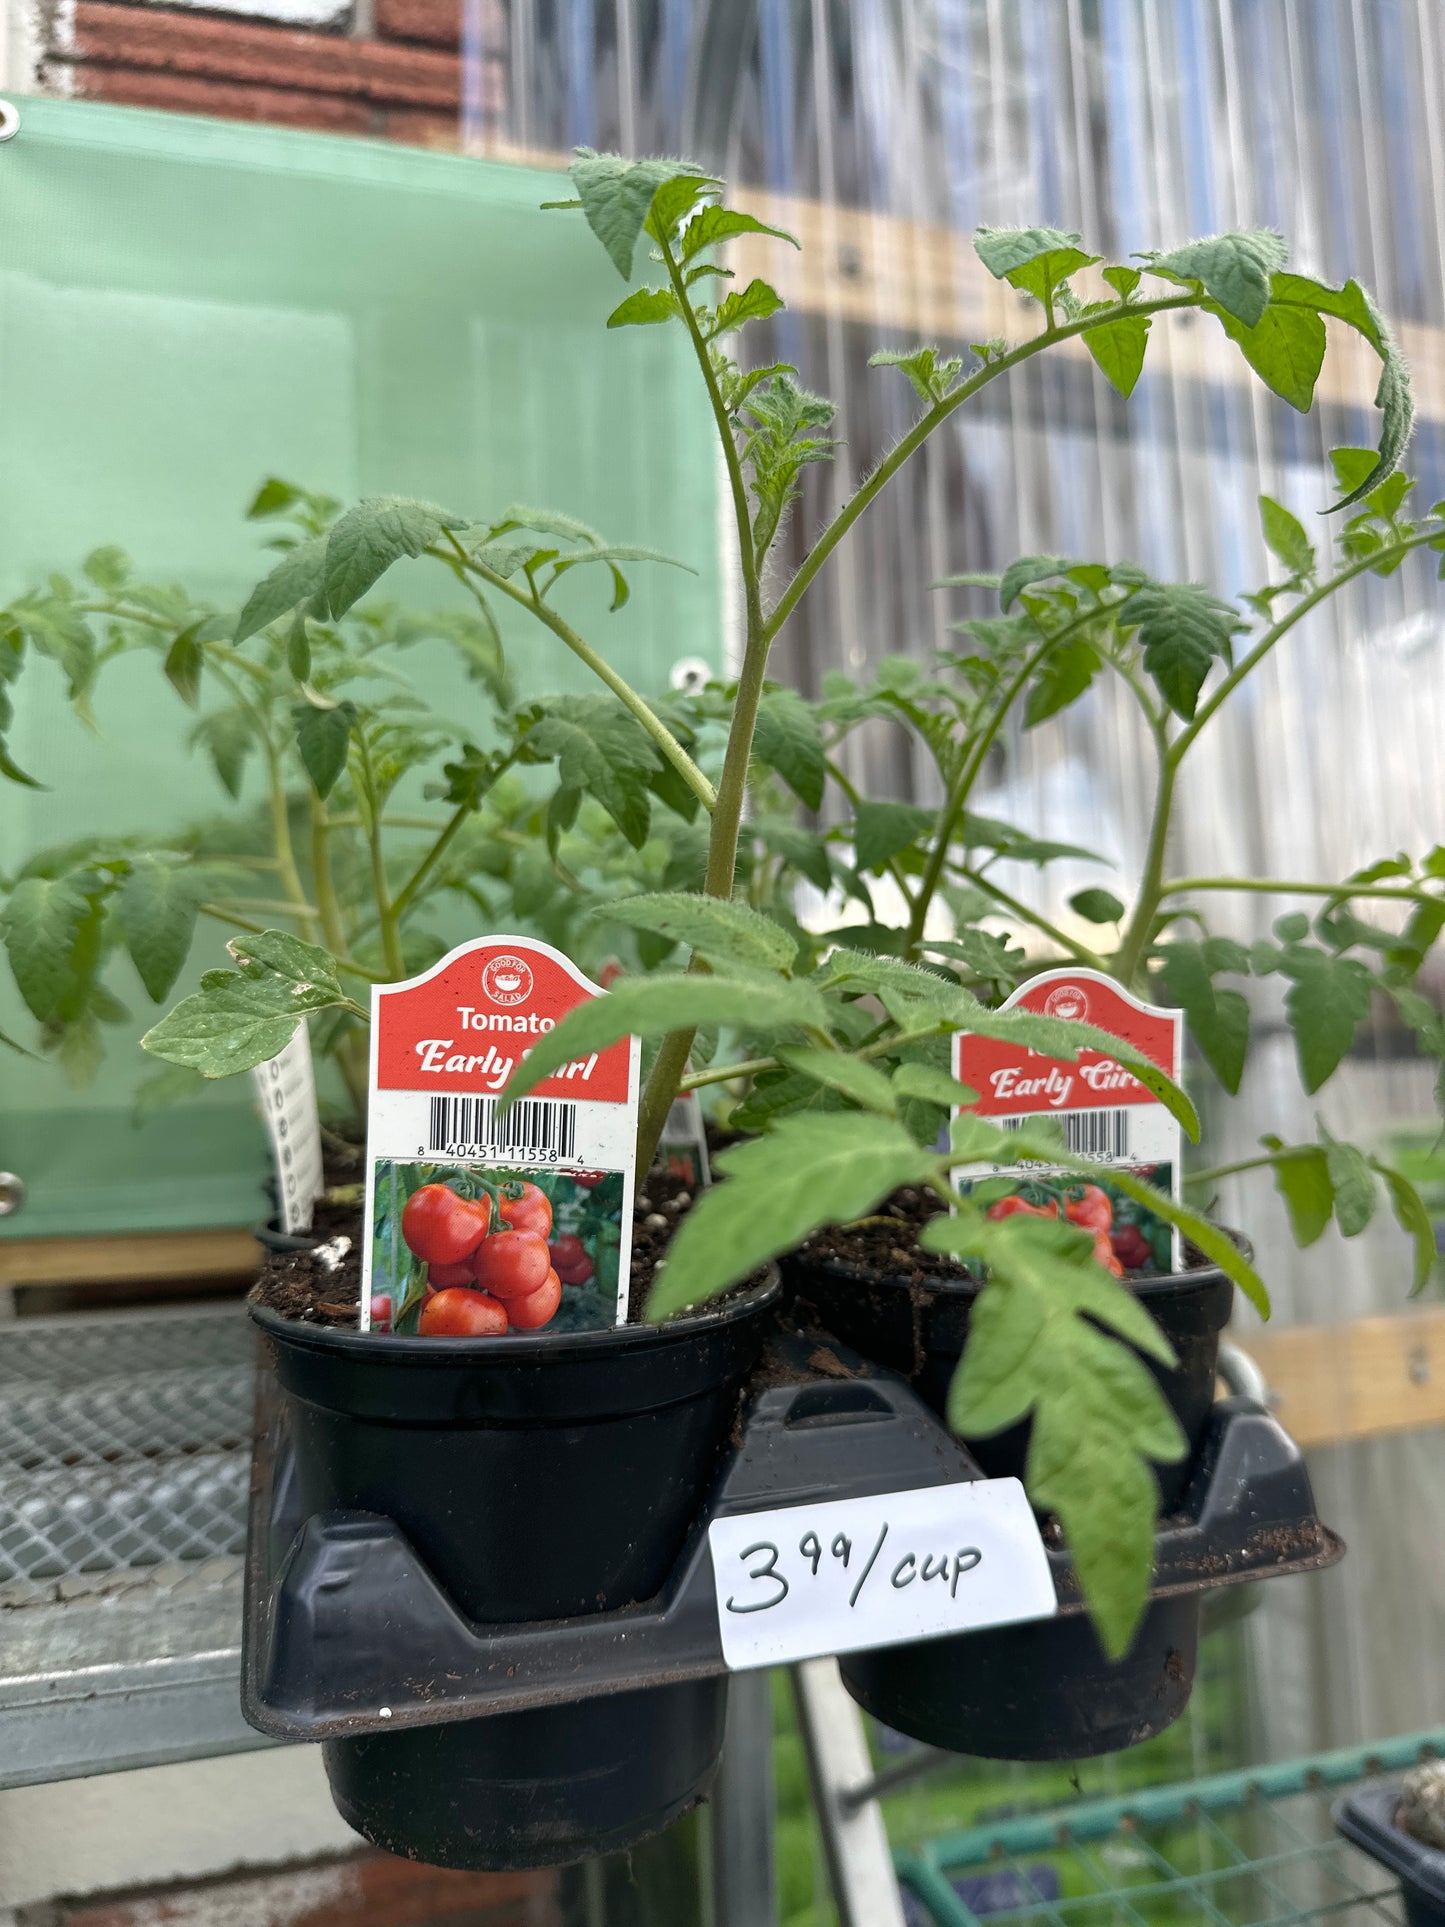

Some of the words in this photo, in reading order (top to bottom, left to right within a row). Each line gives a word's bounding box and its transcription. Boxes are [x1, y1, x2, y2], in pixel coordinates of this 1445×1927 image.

[490, 959, 511, 972] GOOD
[511, 960, 526, 974] FOR
[491, 990, 522, 1002] SALAD
[457, 1006, 556, 1034] Tomato
[415, 1039, 514, 1090] Early
[521, 1050, 599, 1081] irl
[989, 1066, 1074, 1106] Early
[417, 1145, 425, 1157] 8
[445, 1143, 497, 1159] 40451
[507, 1146, 558, 1163] 11558
[576, 1154, 585, 1165] 4
